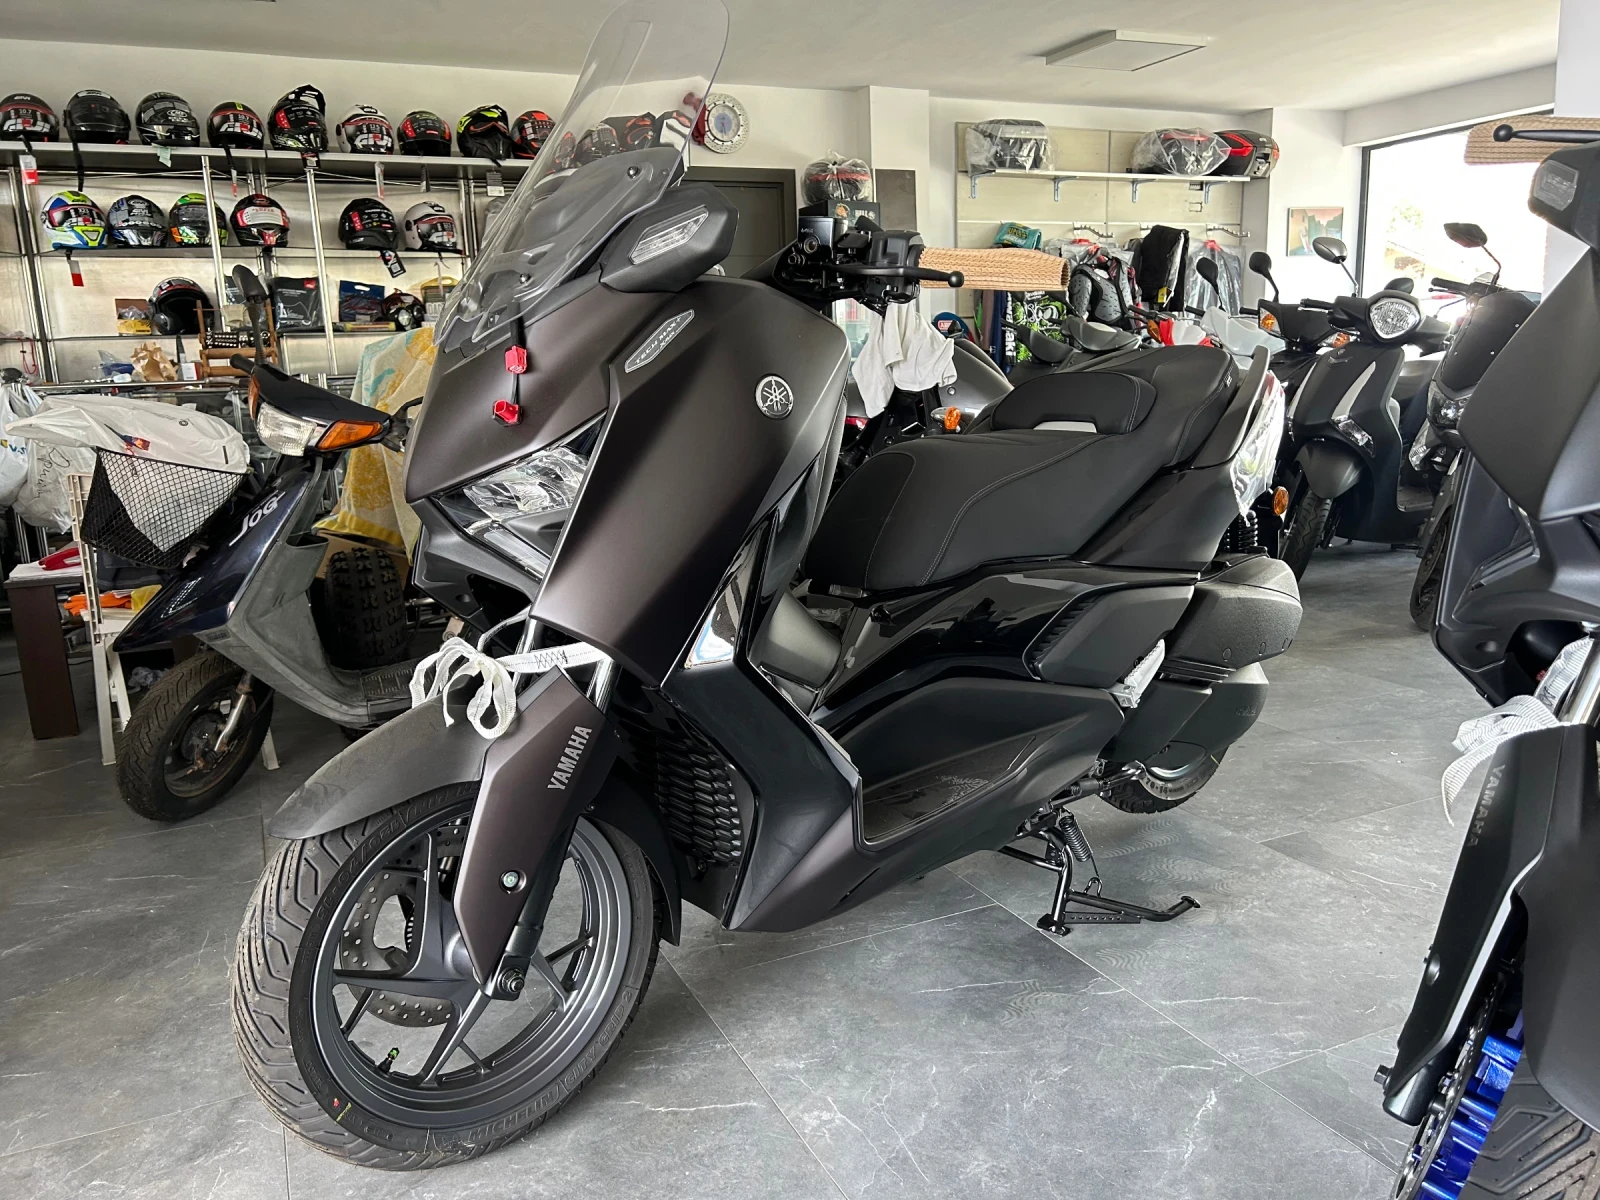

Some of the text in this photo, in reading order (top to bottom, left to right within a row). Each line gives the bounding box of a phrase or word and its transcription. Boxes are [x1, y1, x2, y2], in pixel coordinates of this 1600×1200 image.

[229, 491, 286, 547] JOG
[547, 728, 593, 790] YAMAHA
[1466, 763, 1507, 848] YAMAHA
[467, 1090, 555, 1142] MICHELIN
